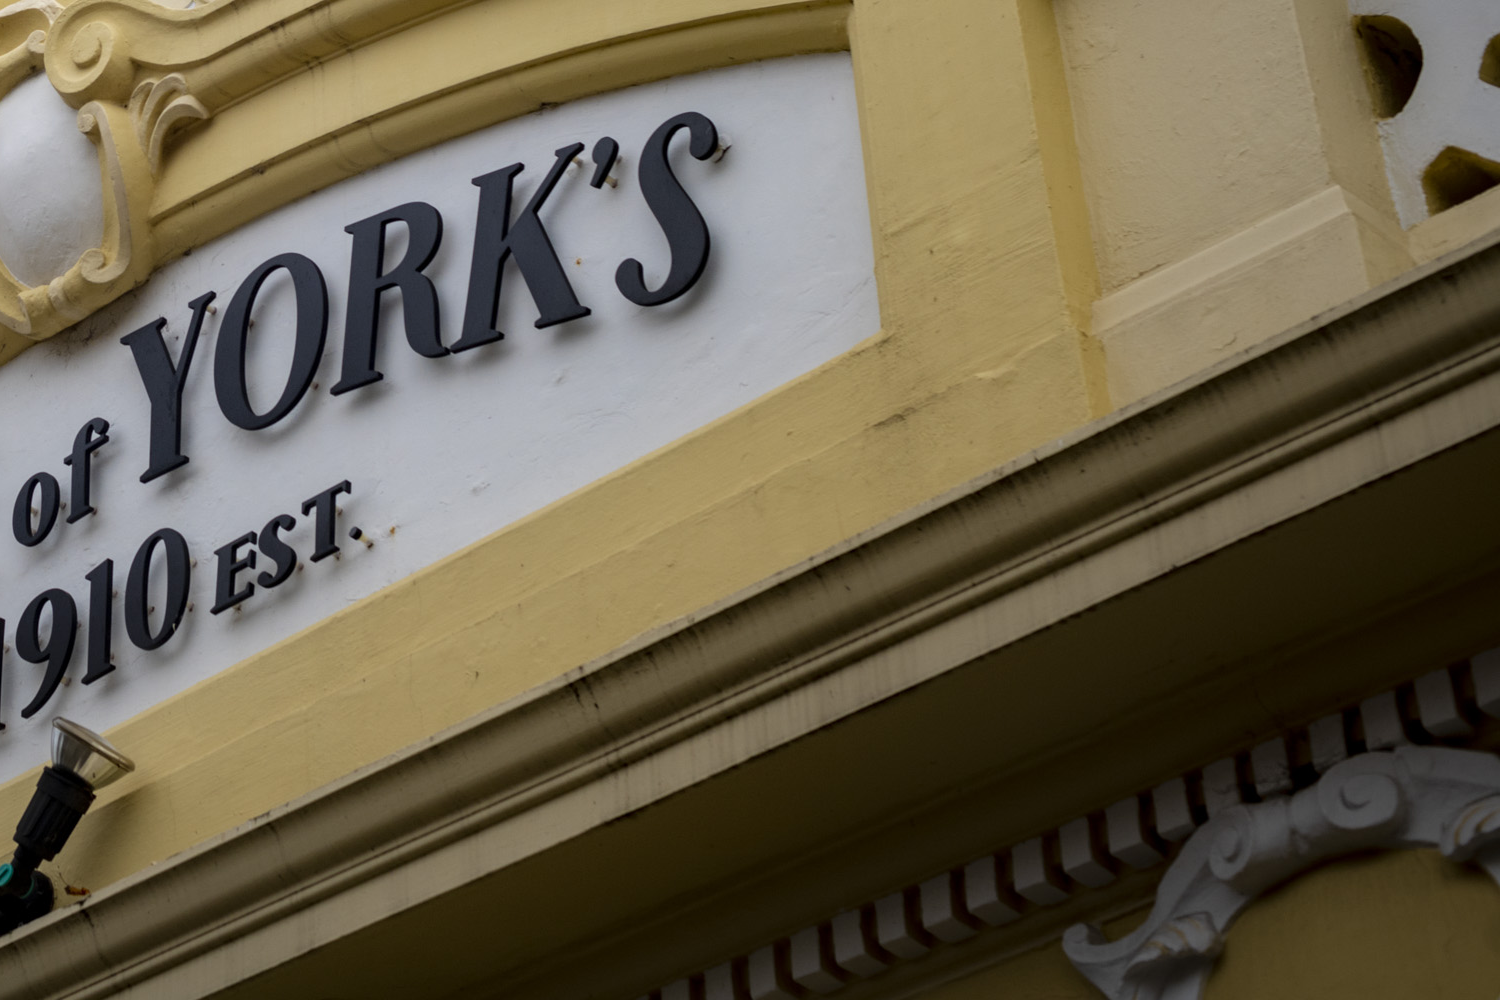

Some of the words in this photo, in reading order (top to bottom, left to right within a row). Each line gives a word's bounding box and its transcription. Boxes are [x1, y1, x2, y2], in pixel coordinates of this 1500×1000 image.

[12, 417, 109, 548] of
[119, 111, 719, 484] YORK'S
[209, 479, 364, 616] EST.
